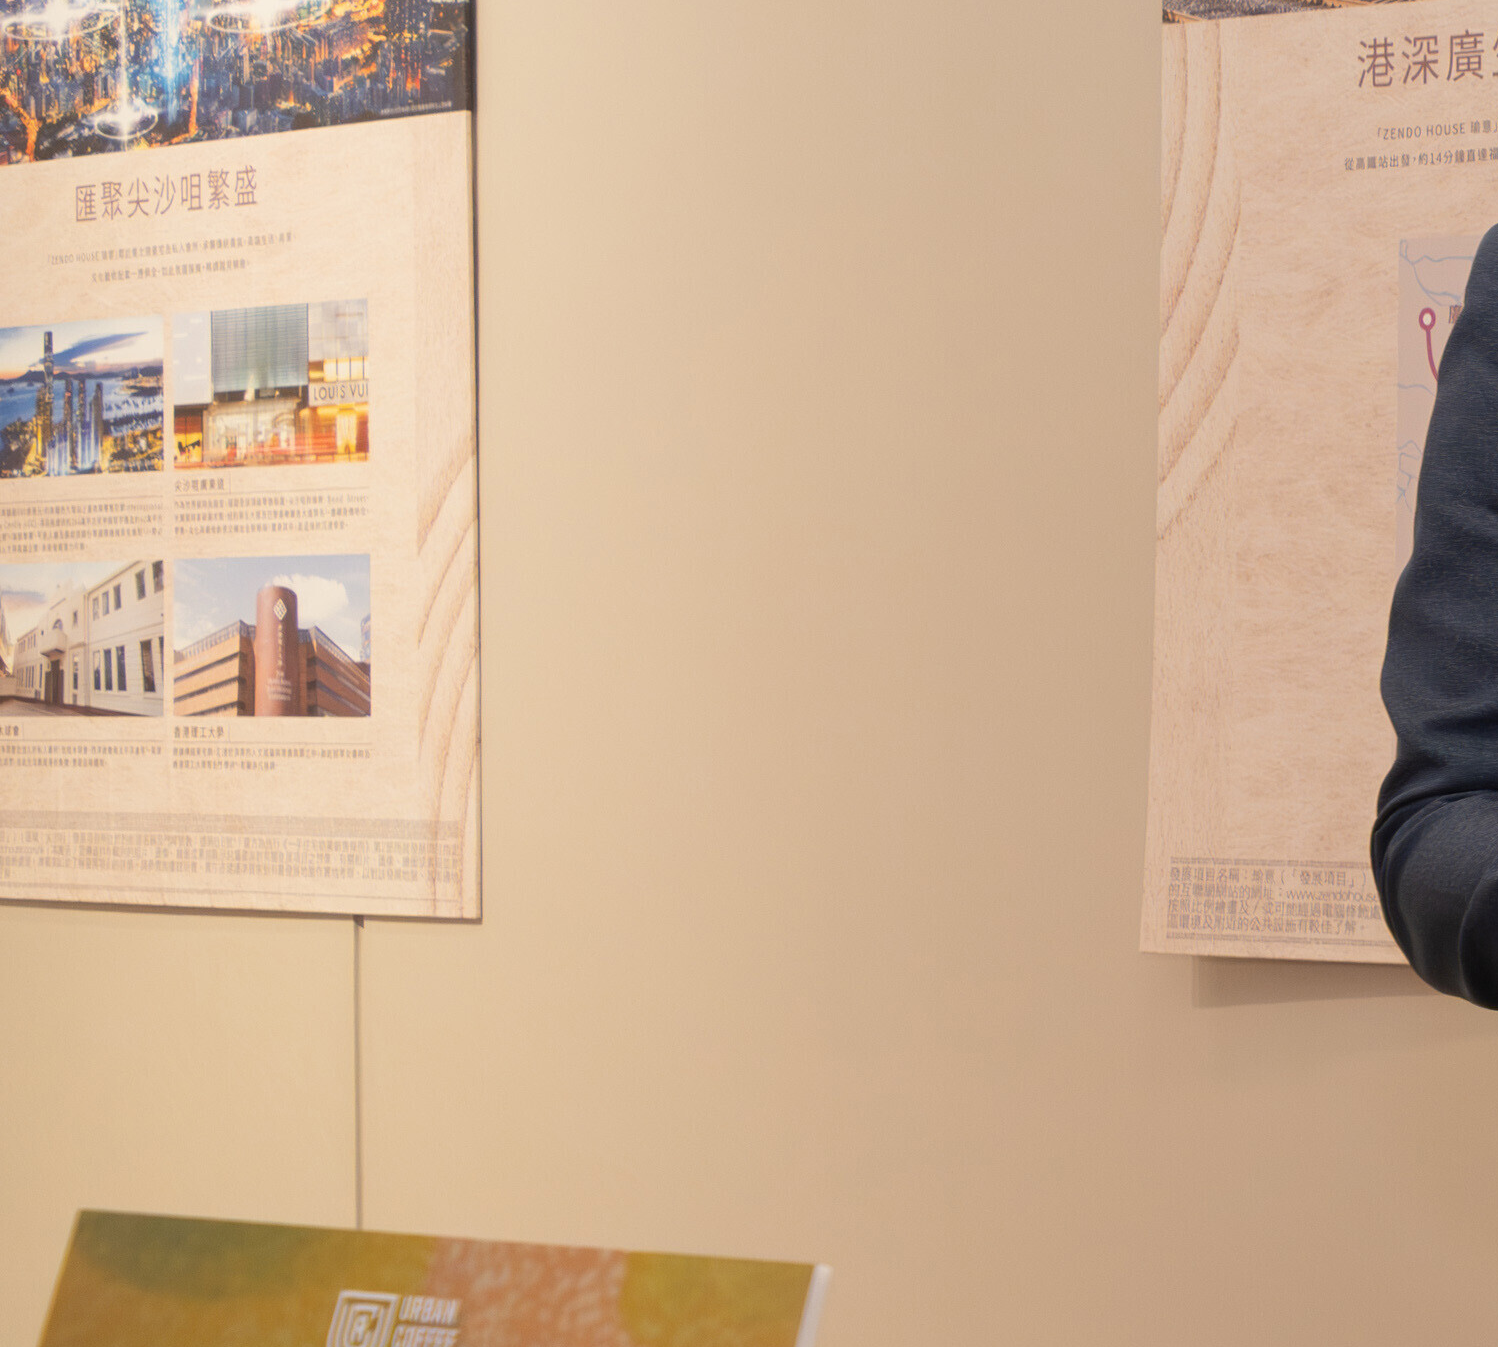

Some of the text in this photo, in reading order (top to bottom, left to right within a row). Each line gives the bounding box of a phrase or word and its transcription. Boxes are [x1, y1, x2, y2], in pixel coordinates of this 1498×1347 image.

[1426, 122, 1465, 136] HOUSE
[75, 164, 259, 224] 匯聚尖沙咀繁盛
[313, 384, 345, 401] LOUIS
[398, 1295, 460, 1326] URBAN
